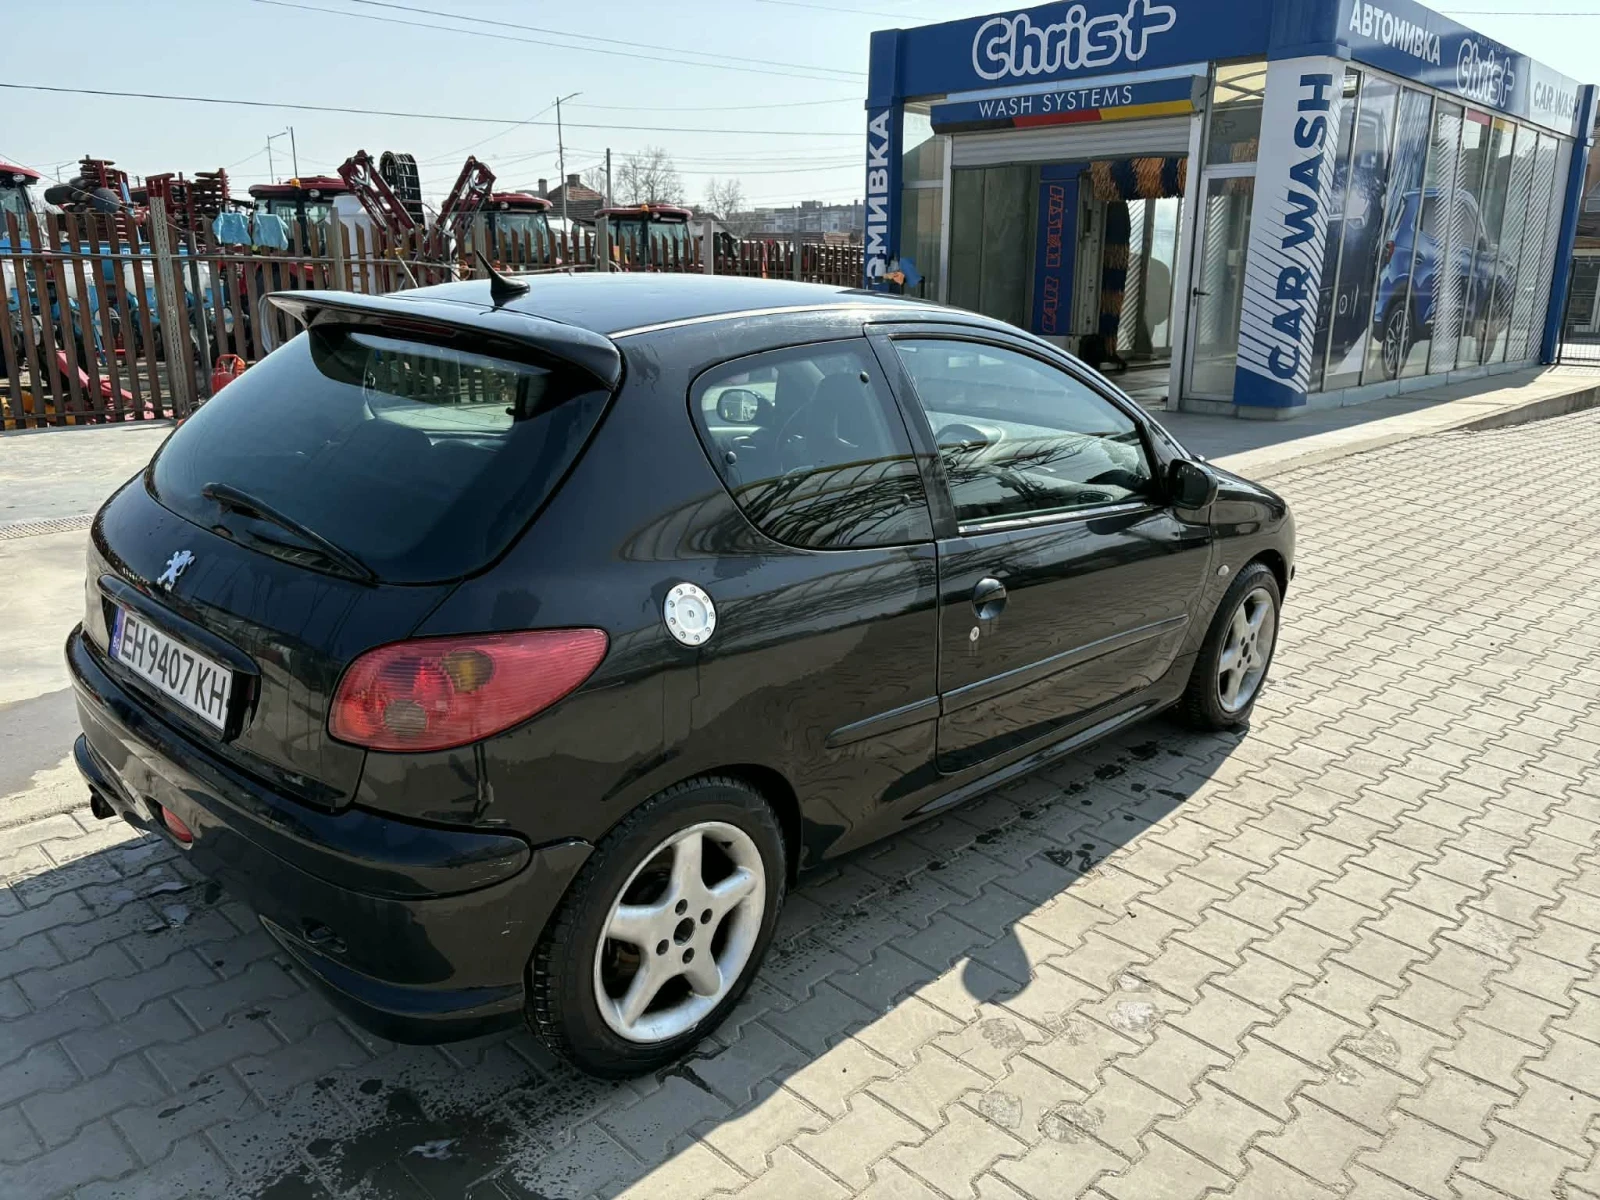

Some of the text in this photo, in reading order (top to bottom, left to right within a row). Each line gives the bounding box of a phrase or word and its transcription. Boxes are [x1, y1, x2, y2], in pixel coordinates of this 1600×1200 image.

[972, 0, 1177, 80] Christ
[1349, 0, 1441, 66] АВТОМИВКА
[978, 86, 1133, 118] WASH SYSTEMS
[1456, 38, 1515, 108] Christ
[1534, 81, 1580, 122] CAR WASH
[866, 109, 890, 290] МИВКА
[1268, 73, 1333, 379] CAR WASH
